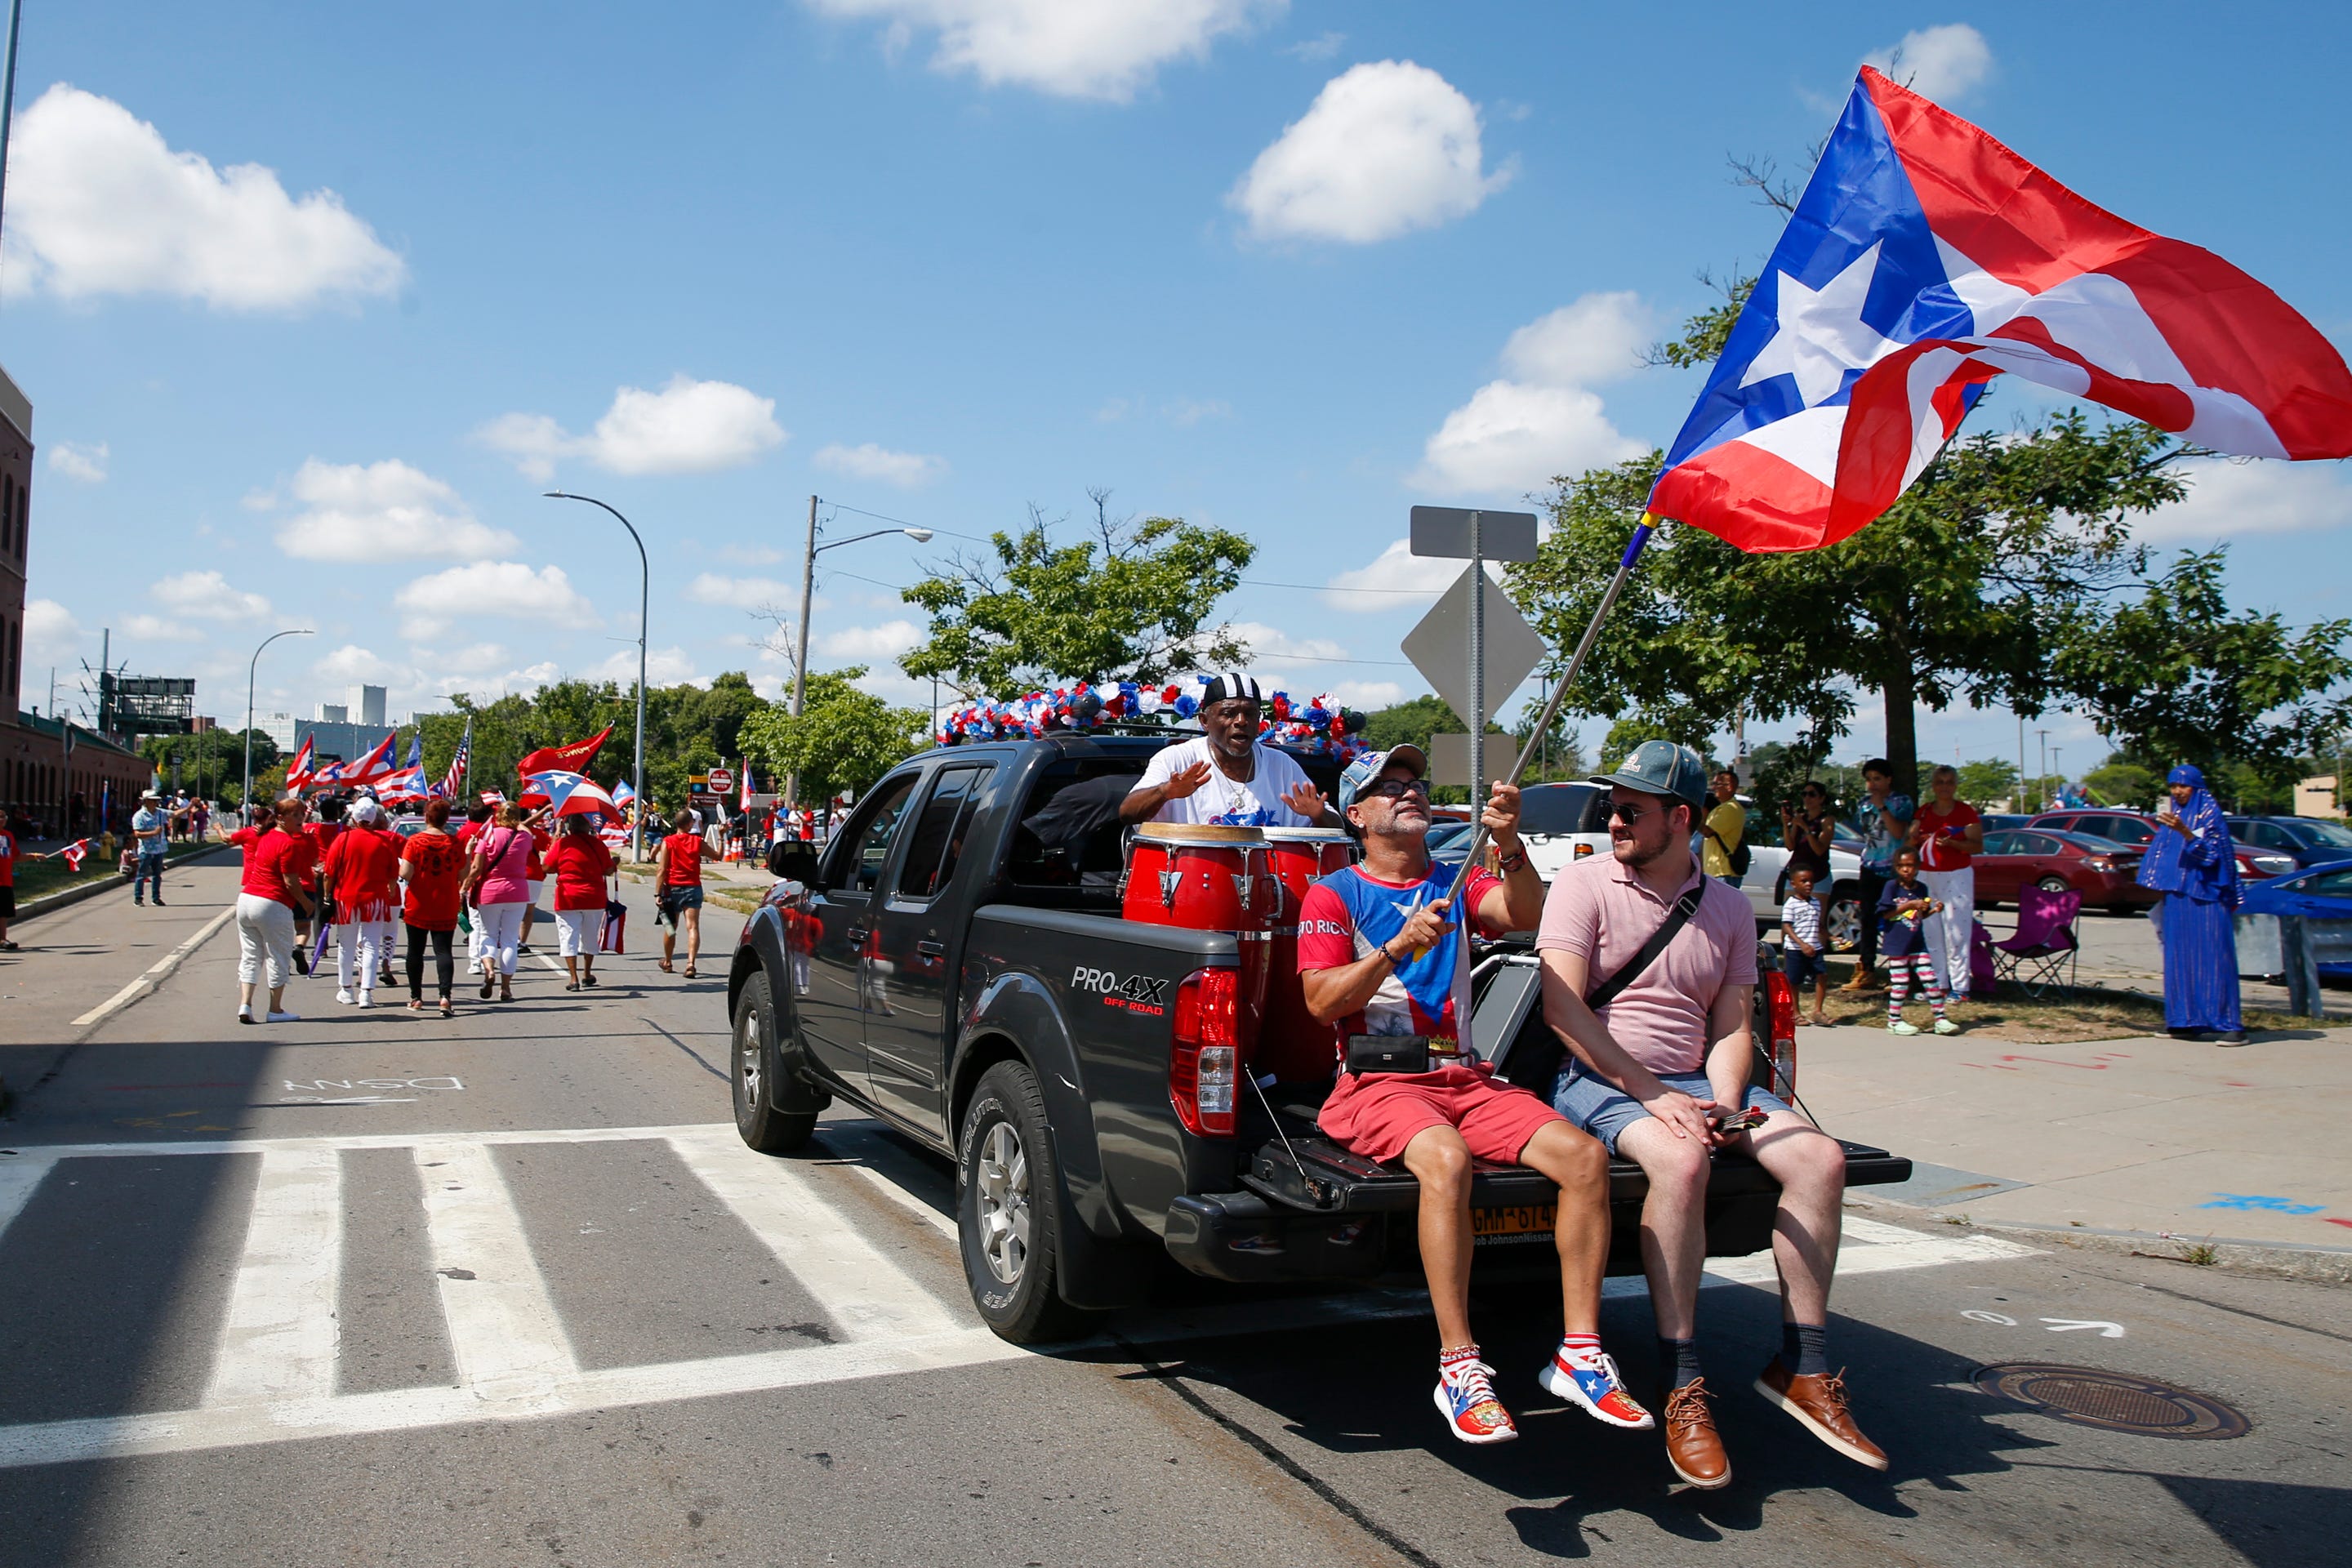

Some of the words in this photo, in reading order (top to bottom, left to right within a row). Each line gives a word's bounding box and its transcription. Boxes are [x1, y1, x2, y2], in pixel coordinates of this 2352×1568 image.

[1740, 742, 1747, 755] 2
[1104, 997, 1126, 1008] OFF
[1129, 1002, 1164, 1015] ROAD
[960, 1098, 1004, 1187] EVOLUTION
[1519, 1206, 1557, 1228] 674
